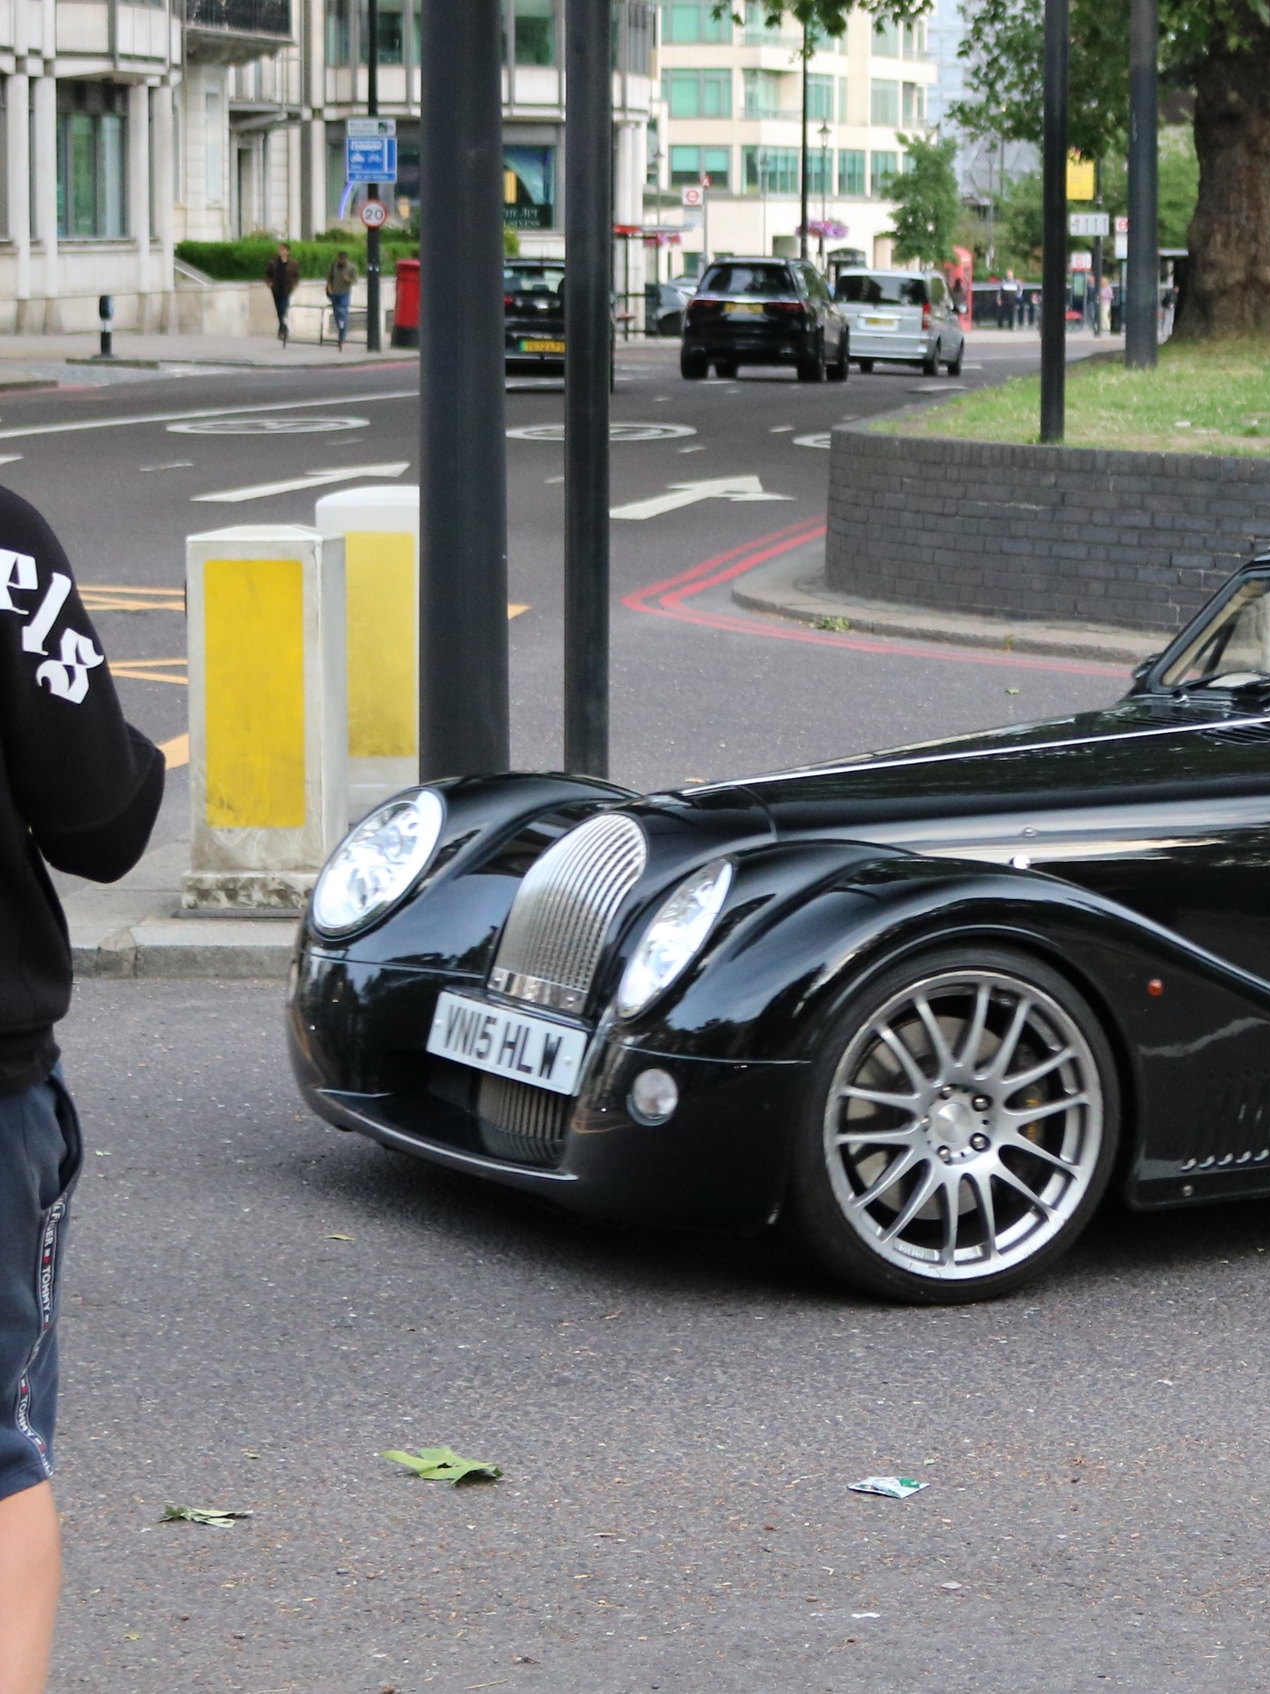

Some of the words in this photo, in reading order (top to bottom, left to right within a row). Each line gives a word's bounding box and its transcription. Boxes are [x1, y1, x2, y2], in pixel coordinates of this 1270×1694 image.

[365, 209, 384, 220] 20
[443, 1004, 498, 1061] VN15
[497, 1021, 563, 1080] HLW
[42, 1265, 51, 1311] TOMMY
[18, 1394, 35, 1437] TOMMY
